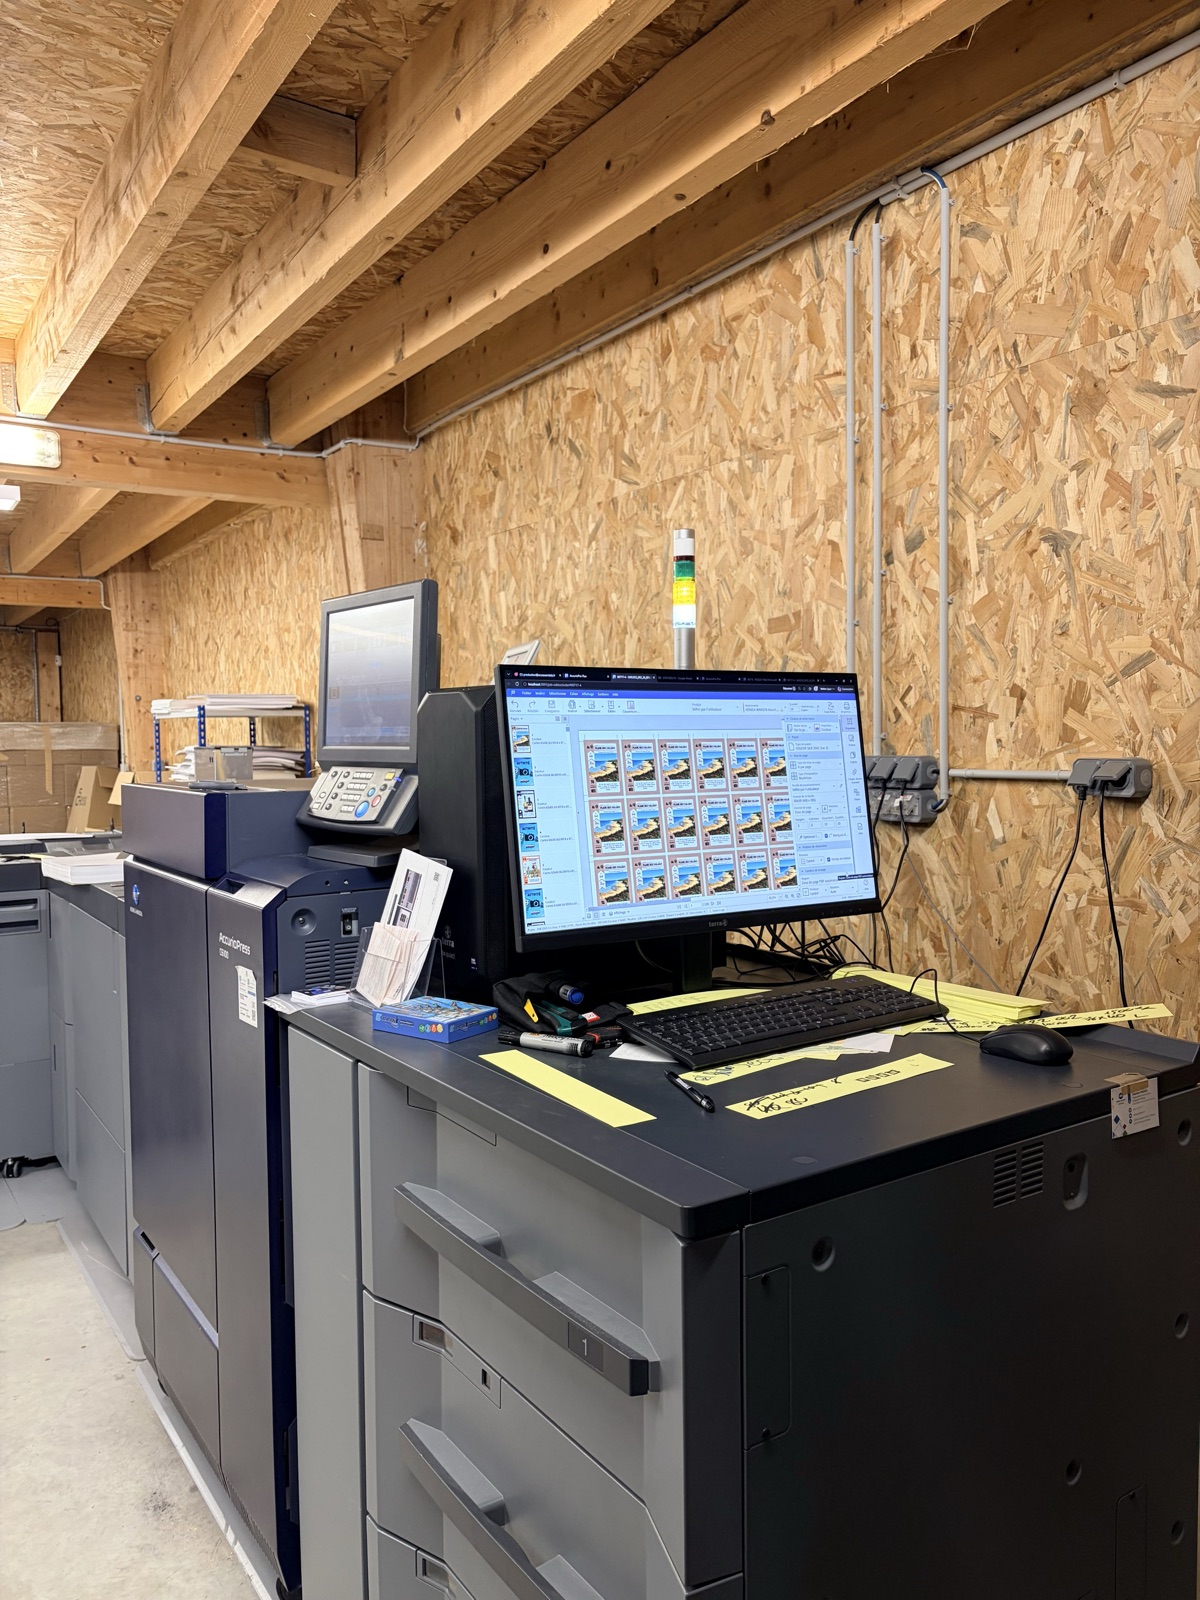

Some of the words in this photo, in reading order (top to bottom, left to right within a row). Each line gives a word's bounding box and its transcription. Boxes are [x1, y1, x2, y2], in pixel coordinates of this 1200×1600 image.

[708, 920, 723, 928] terra
[218, 931, 251, 956] AccurioPress
[581, 1338, 588, 1356] 1
